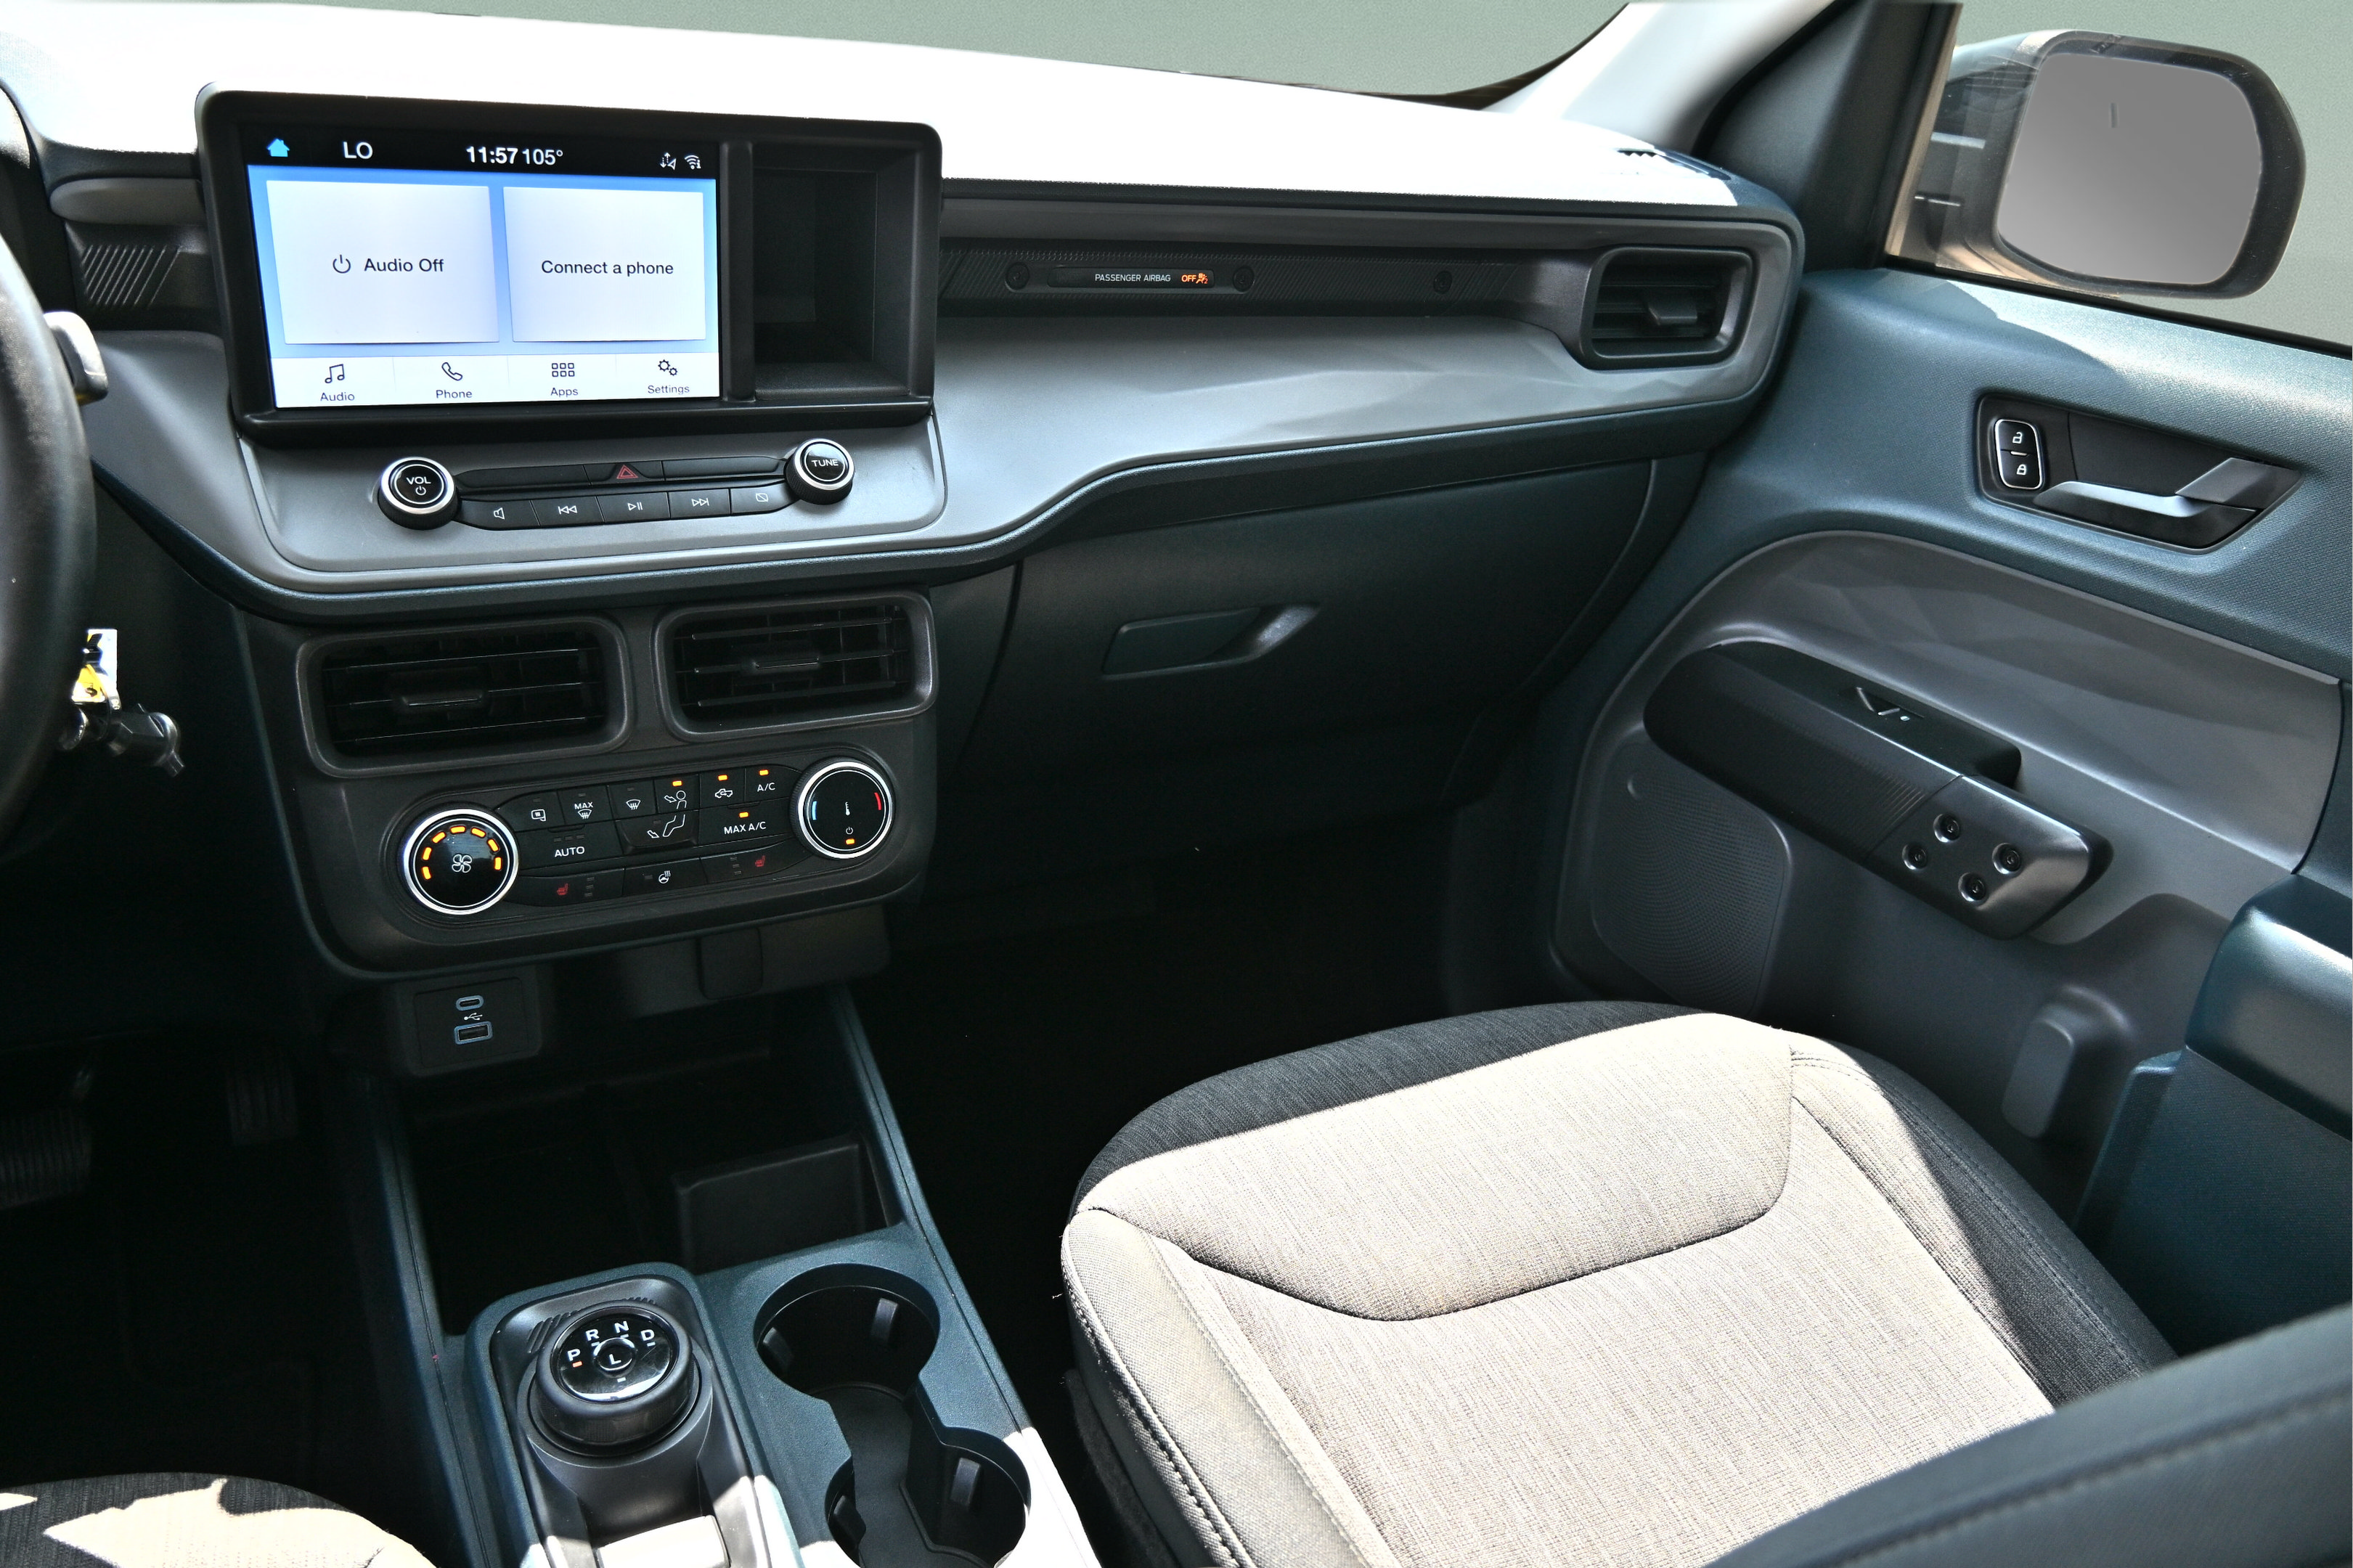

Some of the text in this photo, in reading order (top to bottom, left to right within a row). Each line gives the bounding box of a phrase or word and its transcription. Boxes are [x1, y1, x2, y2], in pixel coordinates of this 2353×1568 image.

[343, 142, 373, 160] LO
[466, 146, 518, 165] 11:57
[364, 258, 444, 272] Audio Off
[541, 260, 674, 277] Connect a phone
[436, 389, 473, 399] Phone
[550, 387, 579, 398] Apps
[648, 385, 690, 395] Settings
[320, 392, 355, 402] Audio
[811, 458, 839, 468] TUNE
[406, 475, 431, 485] VOL
[757, 783, 775, 792] A/C
[724, 821, 767, 835] MAX A/C
[554, 846, 585, 857] AUTO
[567, 1320, 655, 1362] P R N D
[609, 1354, 621, 1365] L
